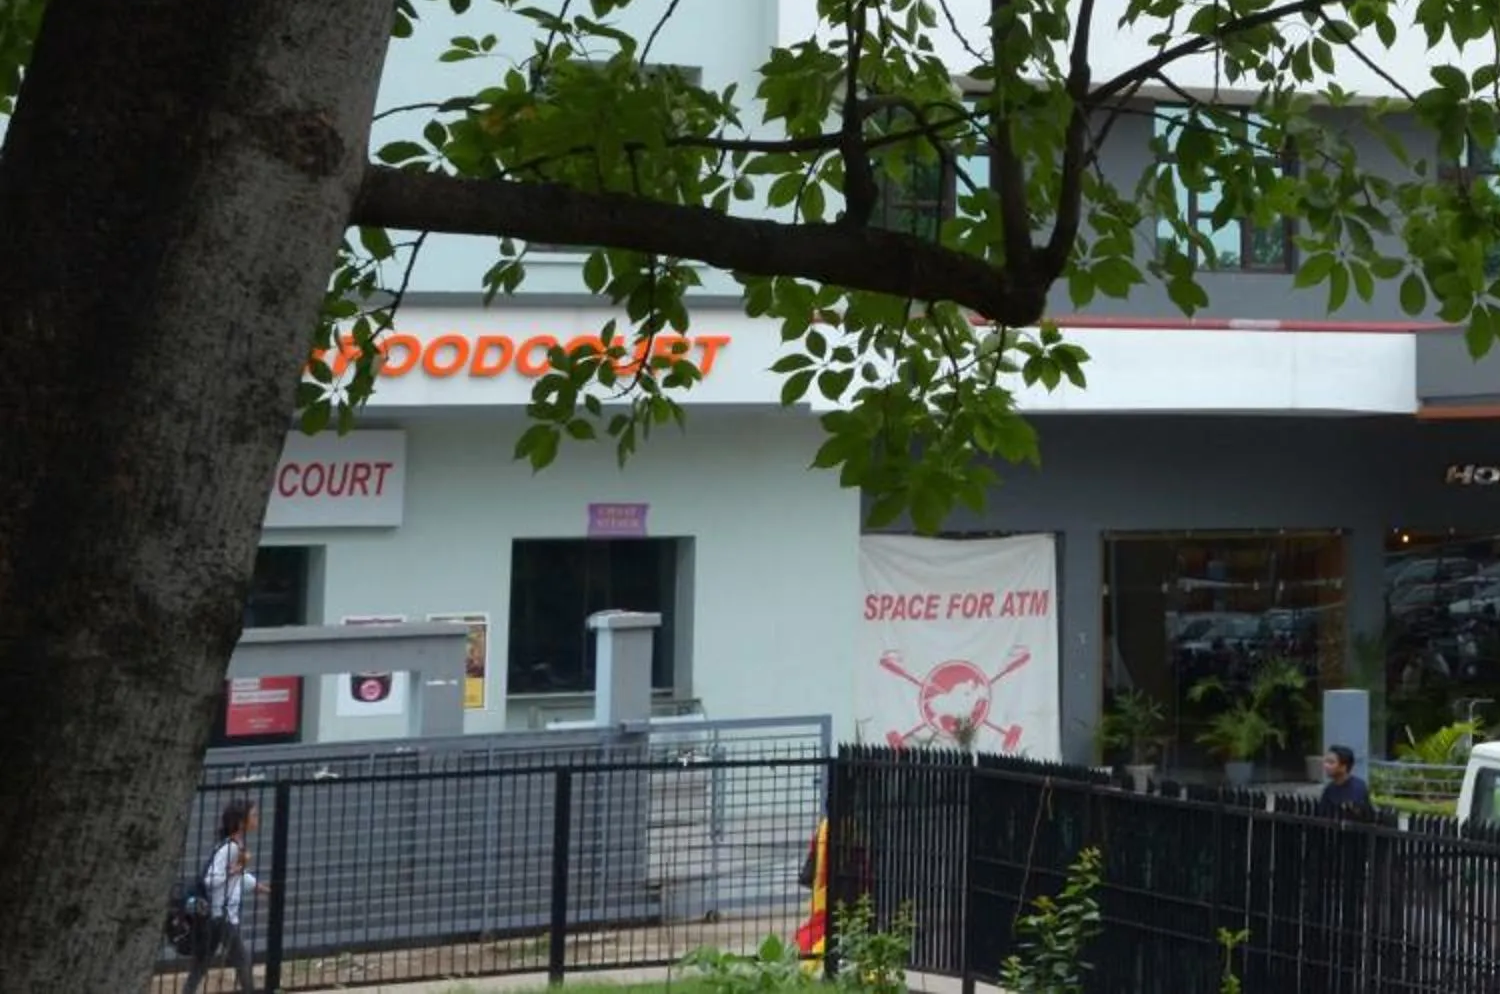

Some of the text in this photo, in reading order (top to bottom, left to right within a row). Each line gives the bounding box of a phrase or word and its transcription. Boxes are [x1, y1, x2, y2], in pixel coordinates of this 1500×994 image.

[278, 462, 394, 497] COURT
[863, 588, 1050, 621] SPACE FOR ATM
